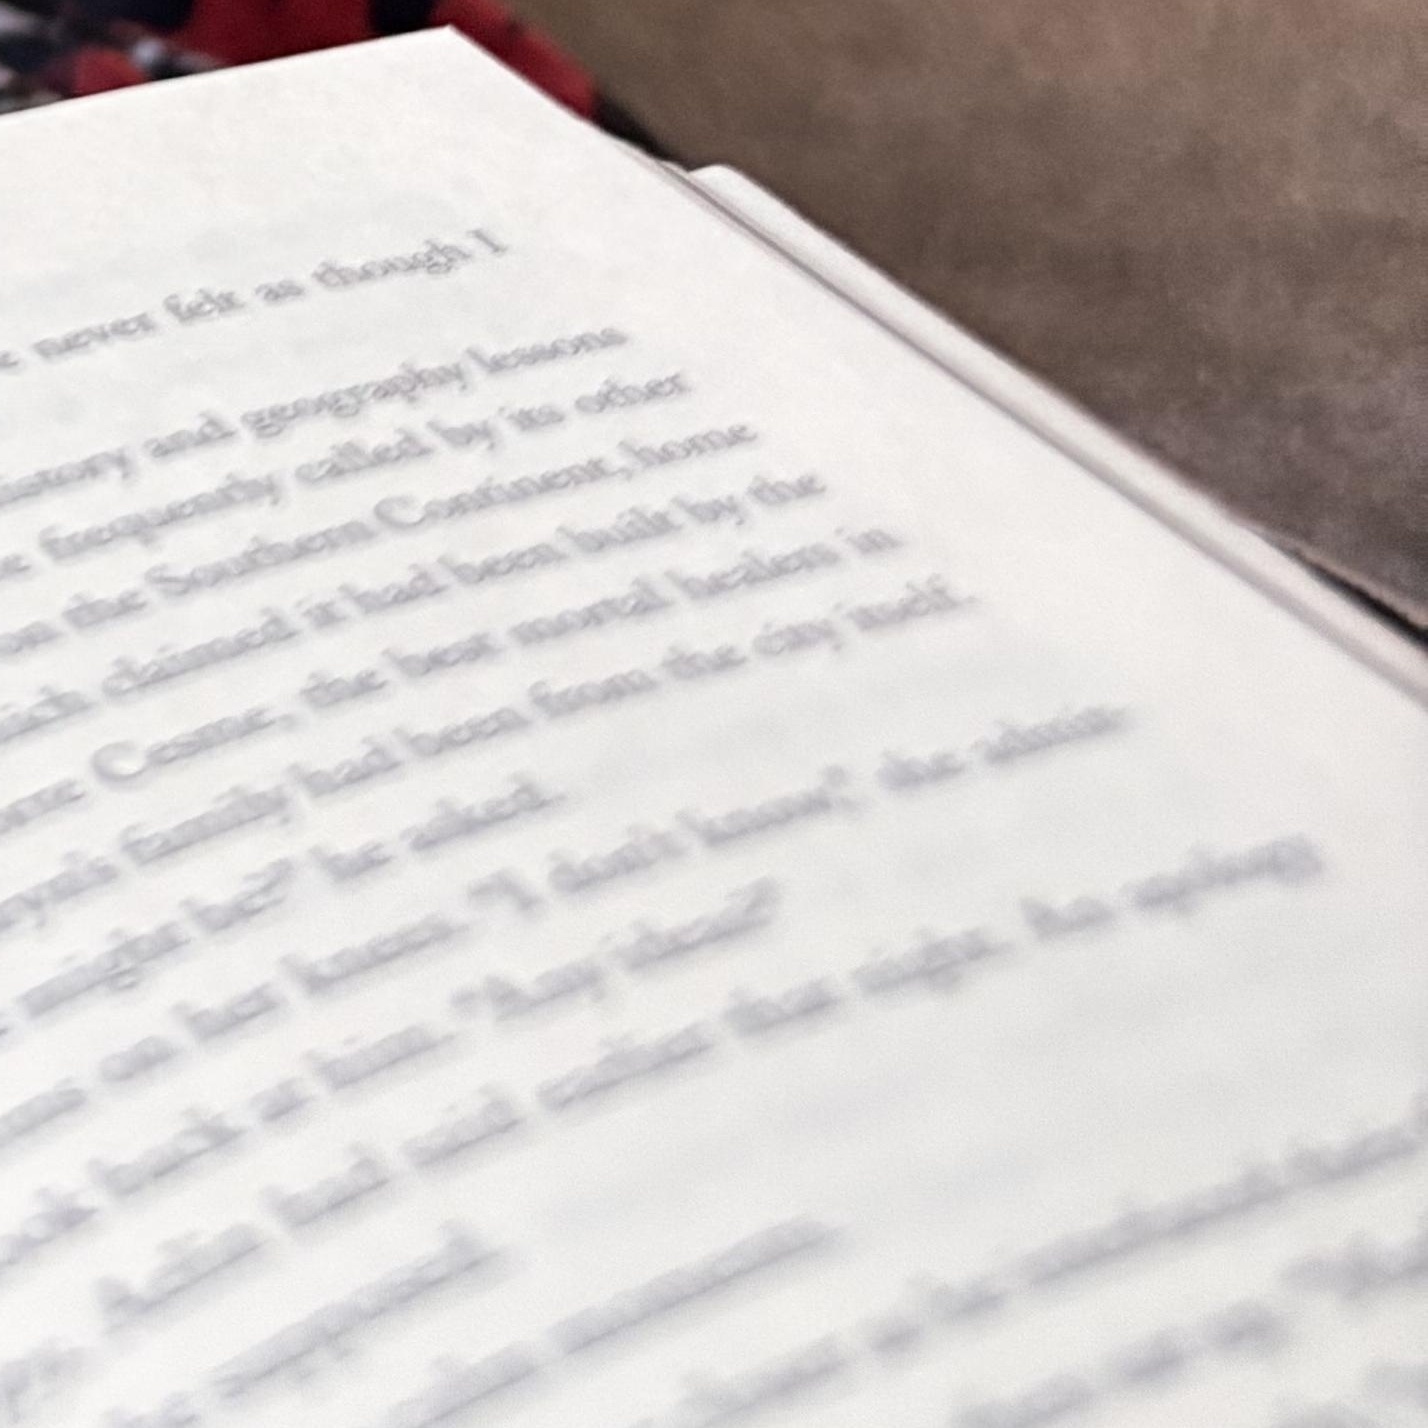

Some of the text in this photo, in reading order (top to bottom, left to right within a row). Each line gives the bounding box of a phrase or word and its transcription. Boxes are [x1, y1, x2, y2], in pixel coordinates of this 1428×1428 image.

[31, 312, 159, 362] never
[163, 289, 247, 326] felt
[254, 280, 307, 305] as
[312, 239, 474, 290] though
[466, 228, 510, 257] I
[38, 473, 283, 564] frequently
[294, 428, 436, 488] called
[426, 420, 501, 454] by
[498, 405, 567, 433] its
[574, 372, 693, 415] other
[142, 412, 237, 462] and
[241, 362, 471, 441] geography
[464, 328, 631, 377] lessons
[62, 590, 149, 633] the
[144, 520, 383, 601] Southern
[373, 458, 637, 534] Continent,
[618, 425, 759, 469] home
[101, 607, 302, 704] claimed
[302, 602, 350, 632] it
[338, 564, 450, 617] had
[437, 543, 571, 587] been
[556, 507, 684, 556] built
[671, 495, 749, 529] by
[747, 474, 828, 508] the
[298, 670, 390, 712] the
[382, 632, 505, 682] best
[508, 577, 676, 648] mortal
[835, 527, 906, 557] in
[119, 785, 294, 867] family
[286, 737, 406, 800] had
[393, 708, 534, 761] been
[528, 671, 662, 721] from
[660, 646, 749, 682] the
[753, 619, 845, 659] city
[308, 843, 396, 887] he
